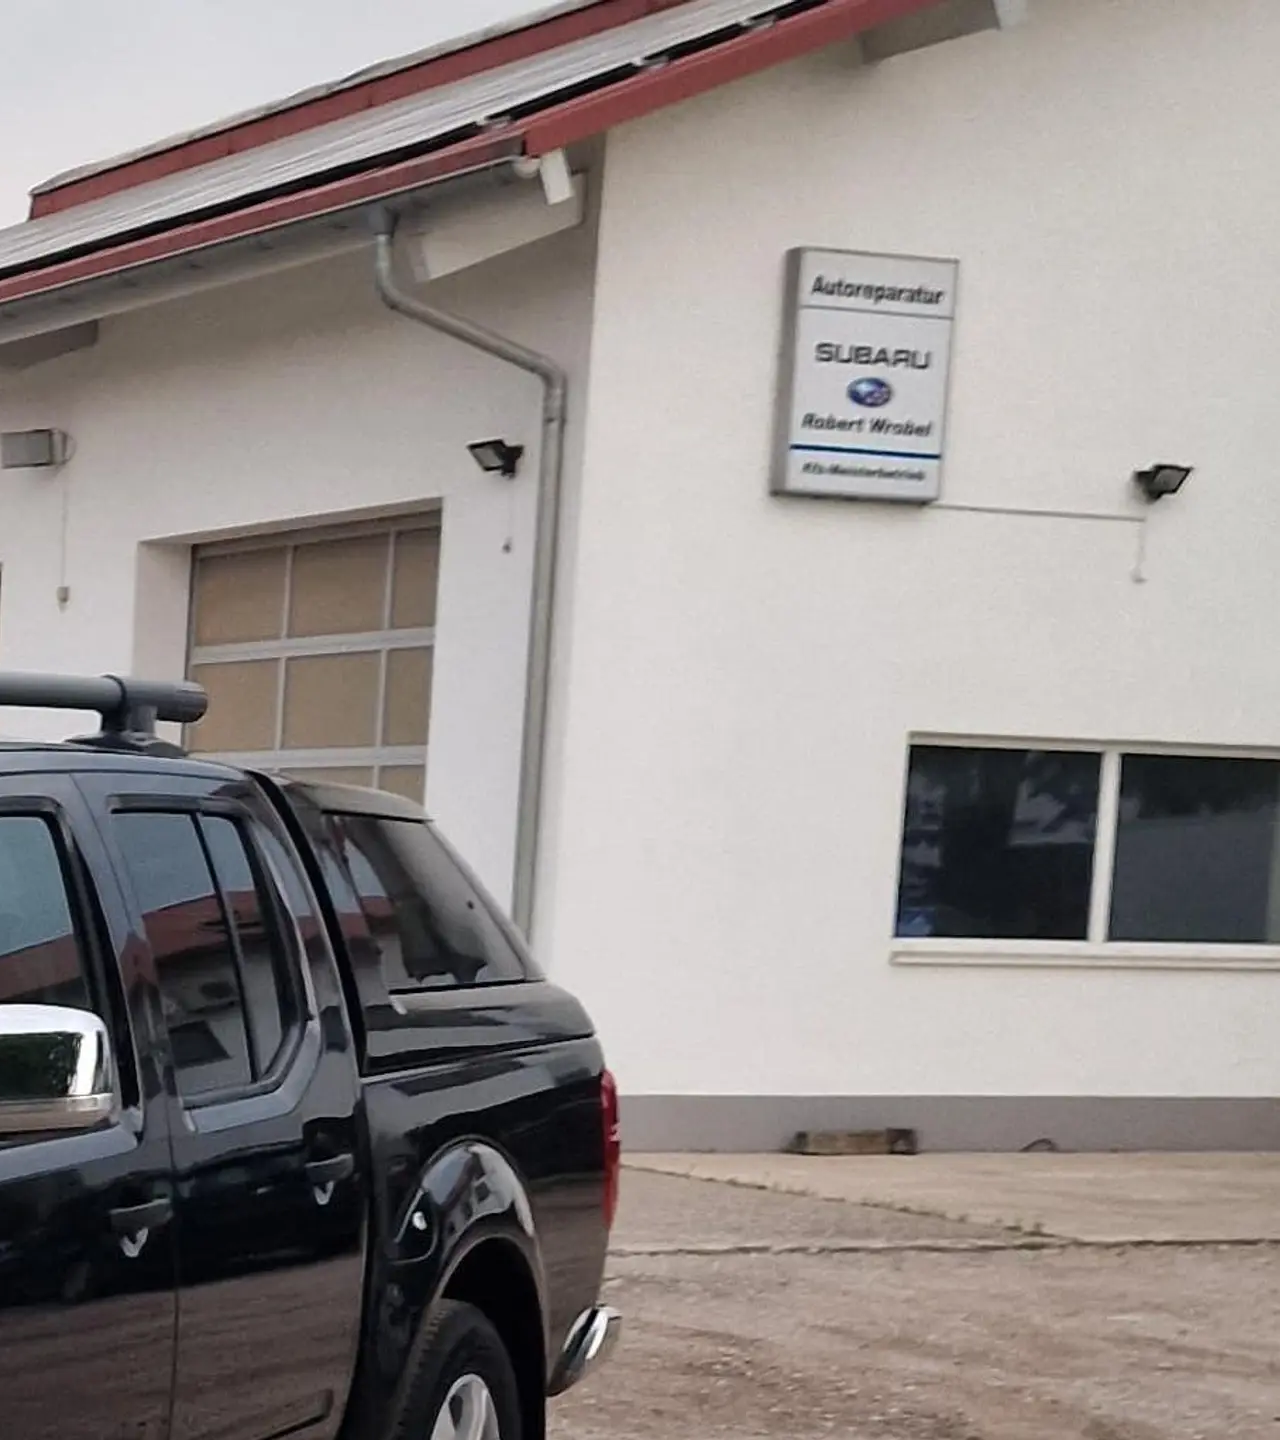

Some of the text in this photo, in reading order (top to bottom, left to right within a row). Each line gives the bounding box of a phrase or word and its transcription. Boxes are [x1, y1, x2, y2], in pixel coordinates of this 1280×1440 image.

[811, 275, 945, 305] Autoreparatur
[814, 342, 933, 370] SUBARU
[801, 413, 933, 437] Robert Wrobel
